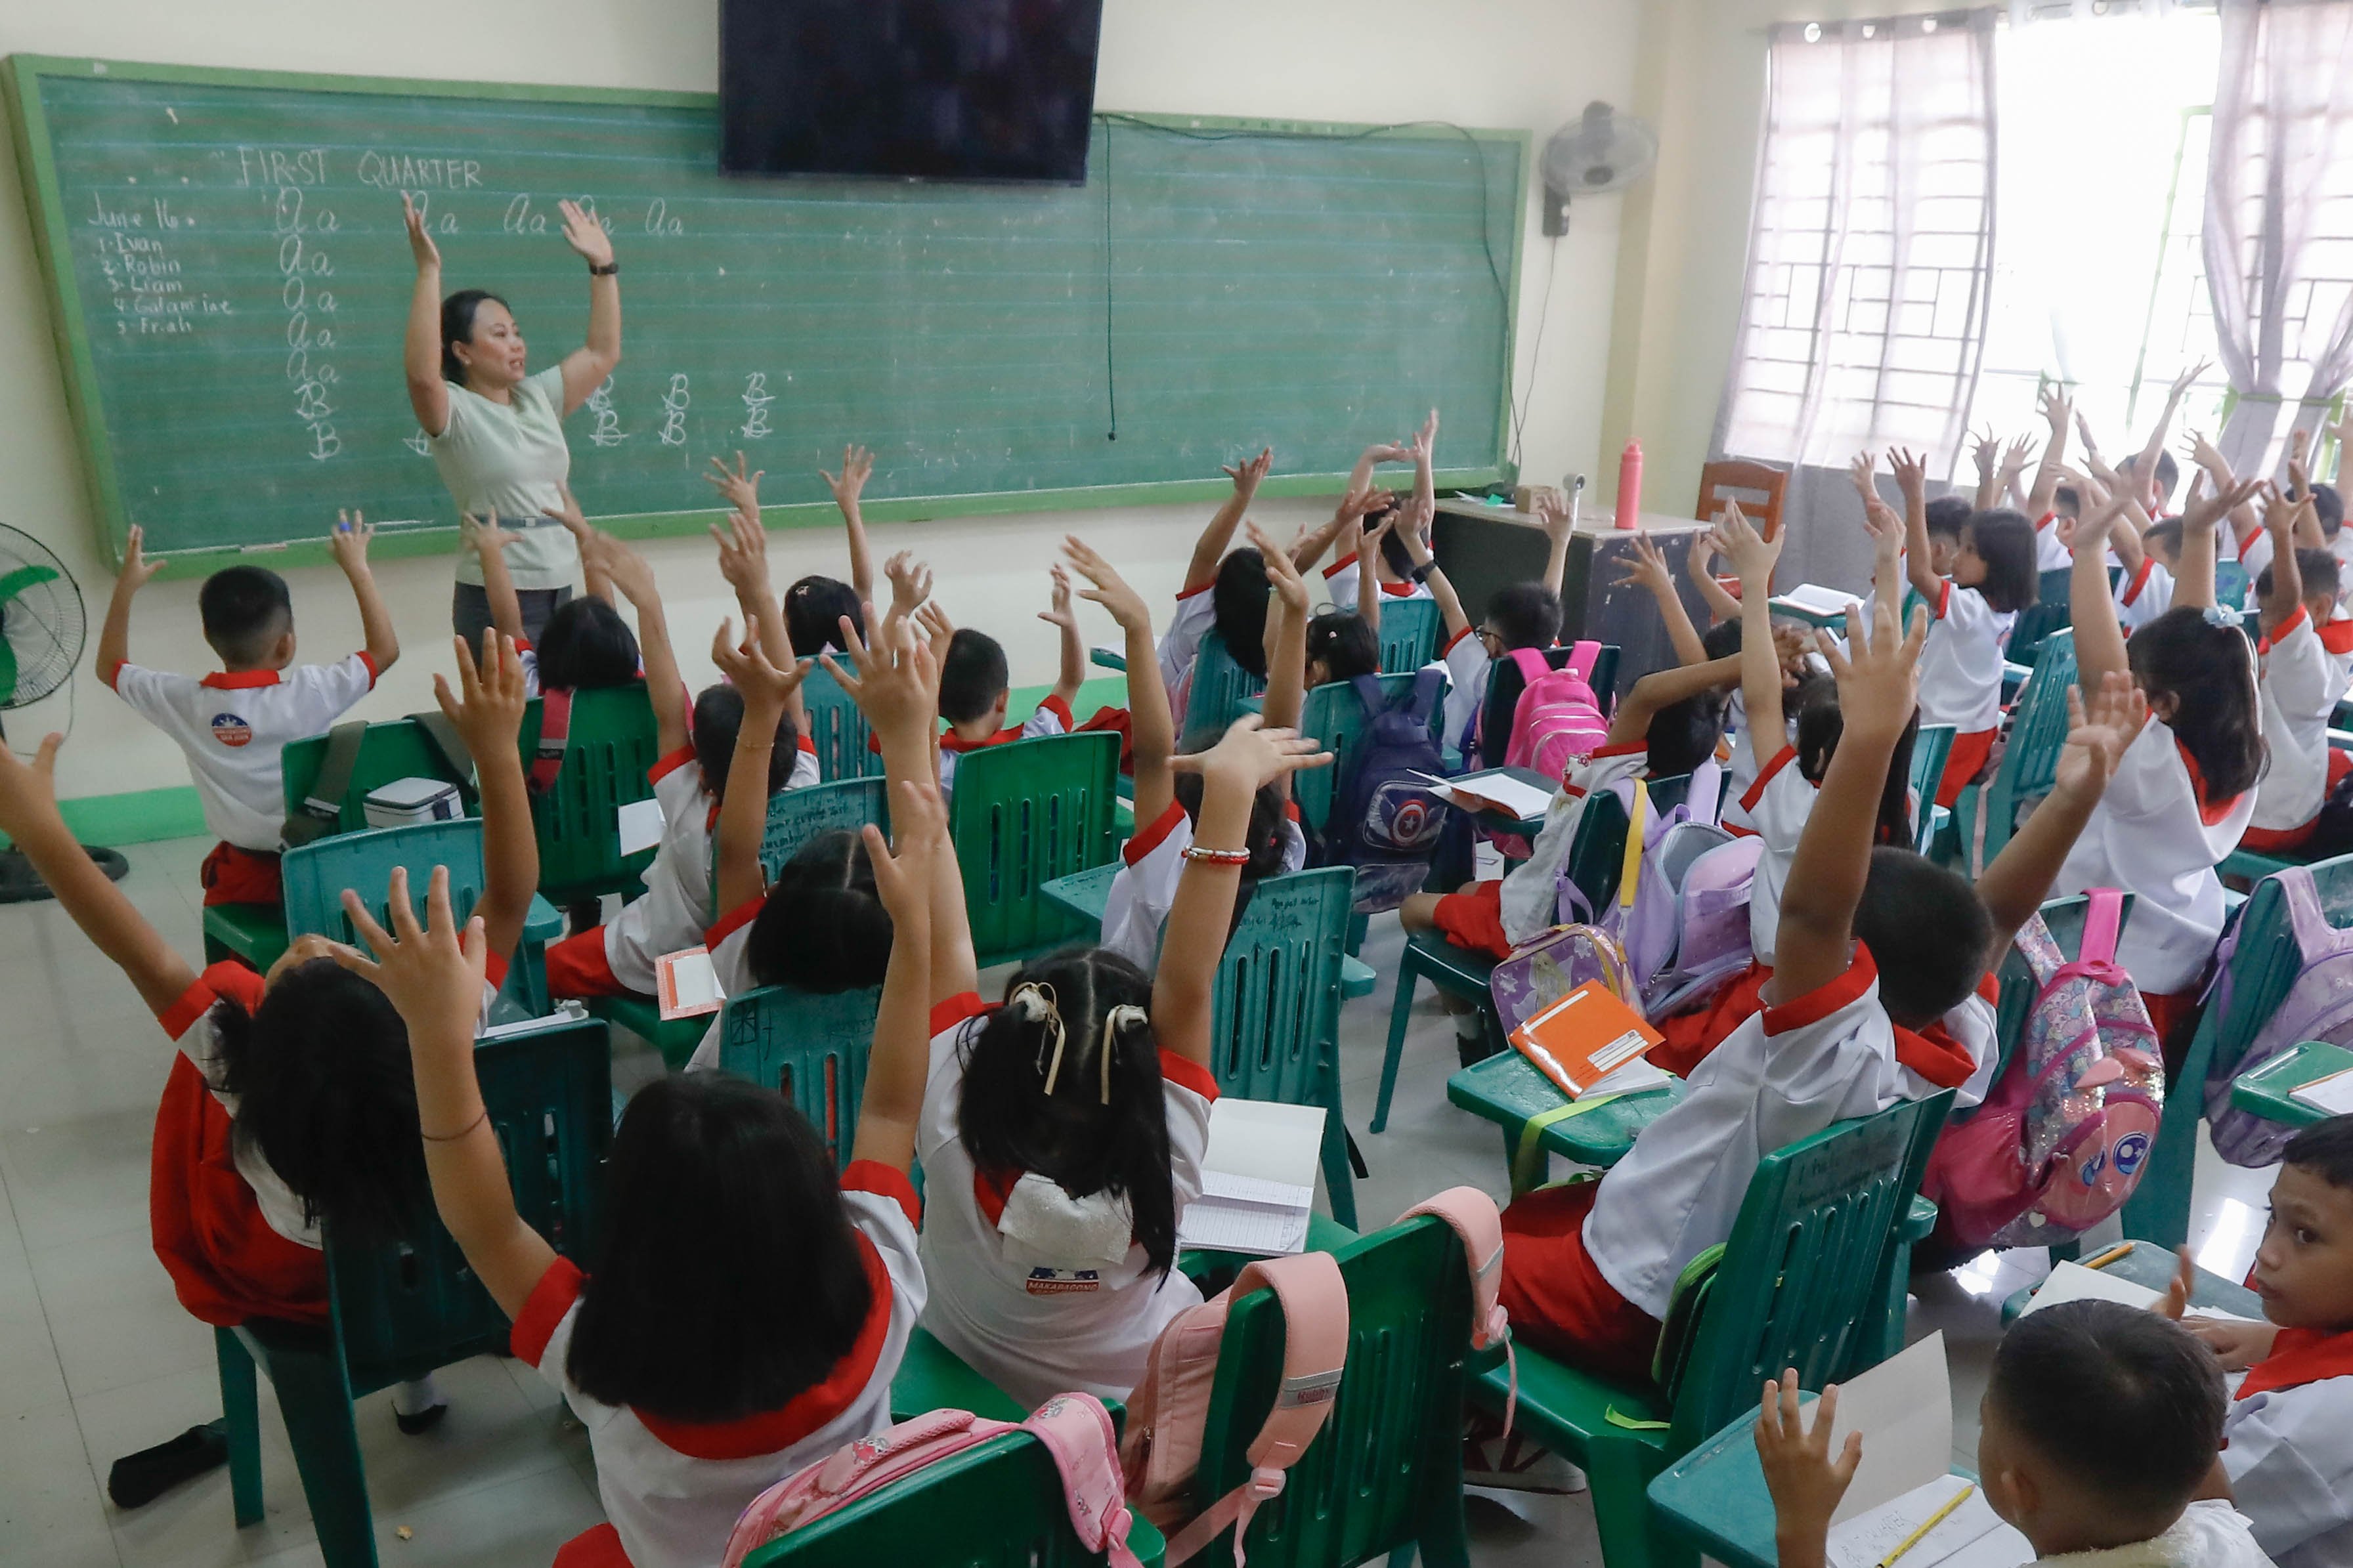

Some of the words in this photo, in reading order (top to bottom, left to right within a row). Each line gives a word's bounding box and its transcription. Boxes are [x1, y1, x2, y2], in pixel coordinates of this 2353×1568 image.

[237, 146, 326, 187] FIRST
[358, 150, 483, 189] QUARTER
[88, 192, 141, 228] June
[114, 232, 164, 259] Ivan
[123, 254, 181, 276] Robin
[131, 276, 182, 293] Liam
